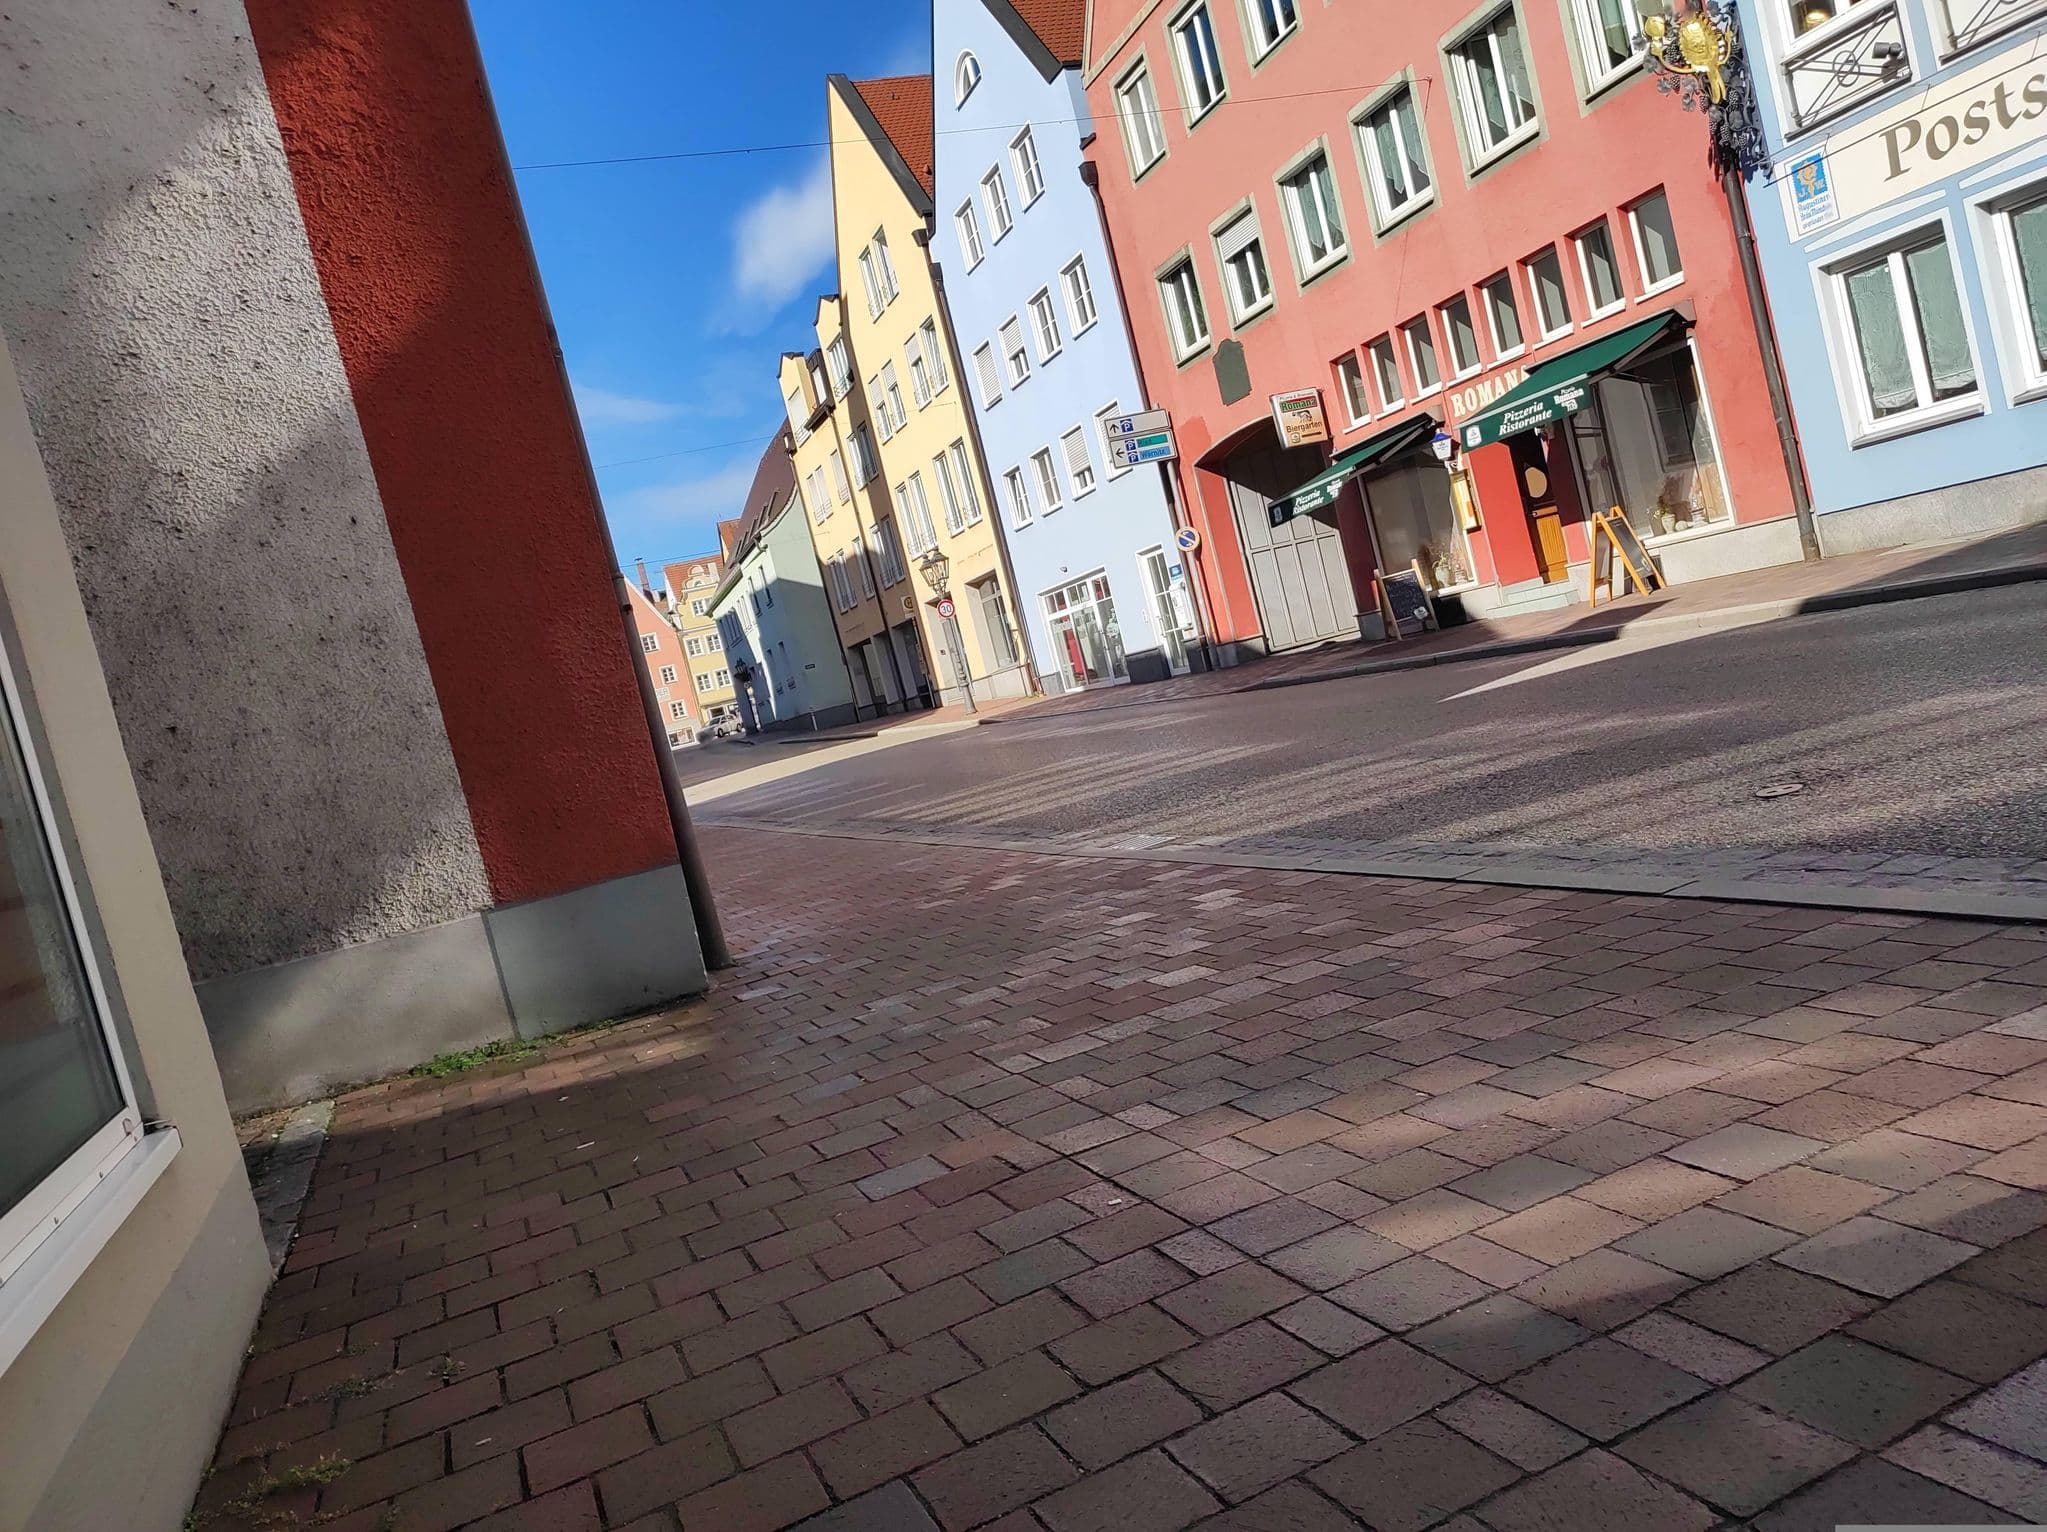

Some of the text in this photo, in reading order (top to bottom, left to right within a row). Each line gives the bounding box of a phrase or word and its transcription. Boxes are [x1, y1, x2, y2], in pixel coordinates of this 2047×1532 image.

[1281, 399, 1317, 411] Romana
[1504, 402, 1543, 424] Pizzeria
[1286, 421, 1322, 433] Biergarten
[1499, 409, 1552, 436] Ristorante
[1293, 496, 1324, 515] Ristorante
[1296, 490, 1320, 506] Pizzeria
[941, 604, 952, 614] 30
